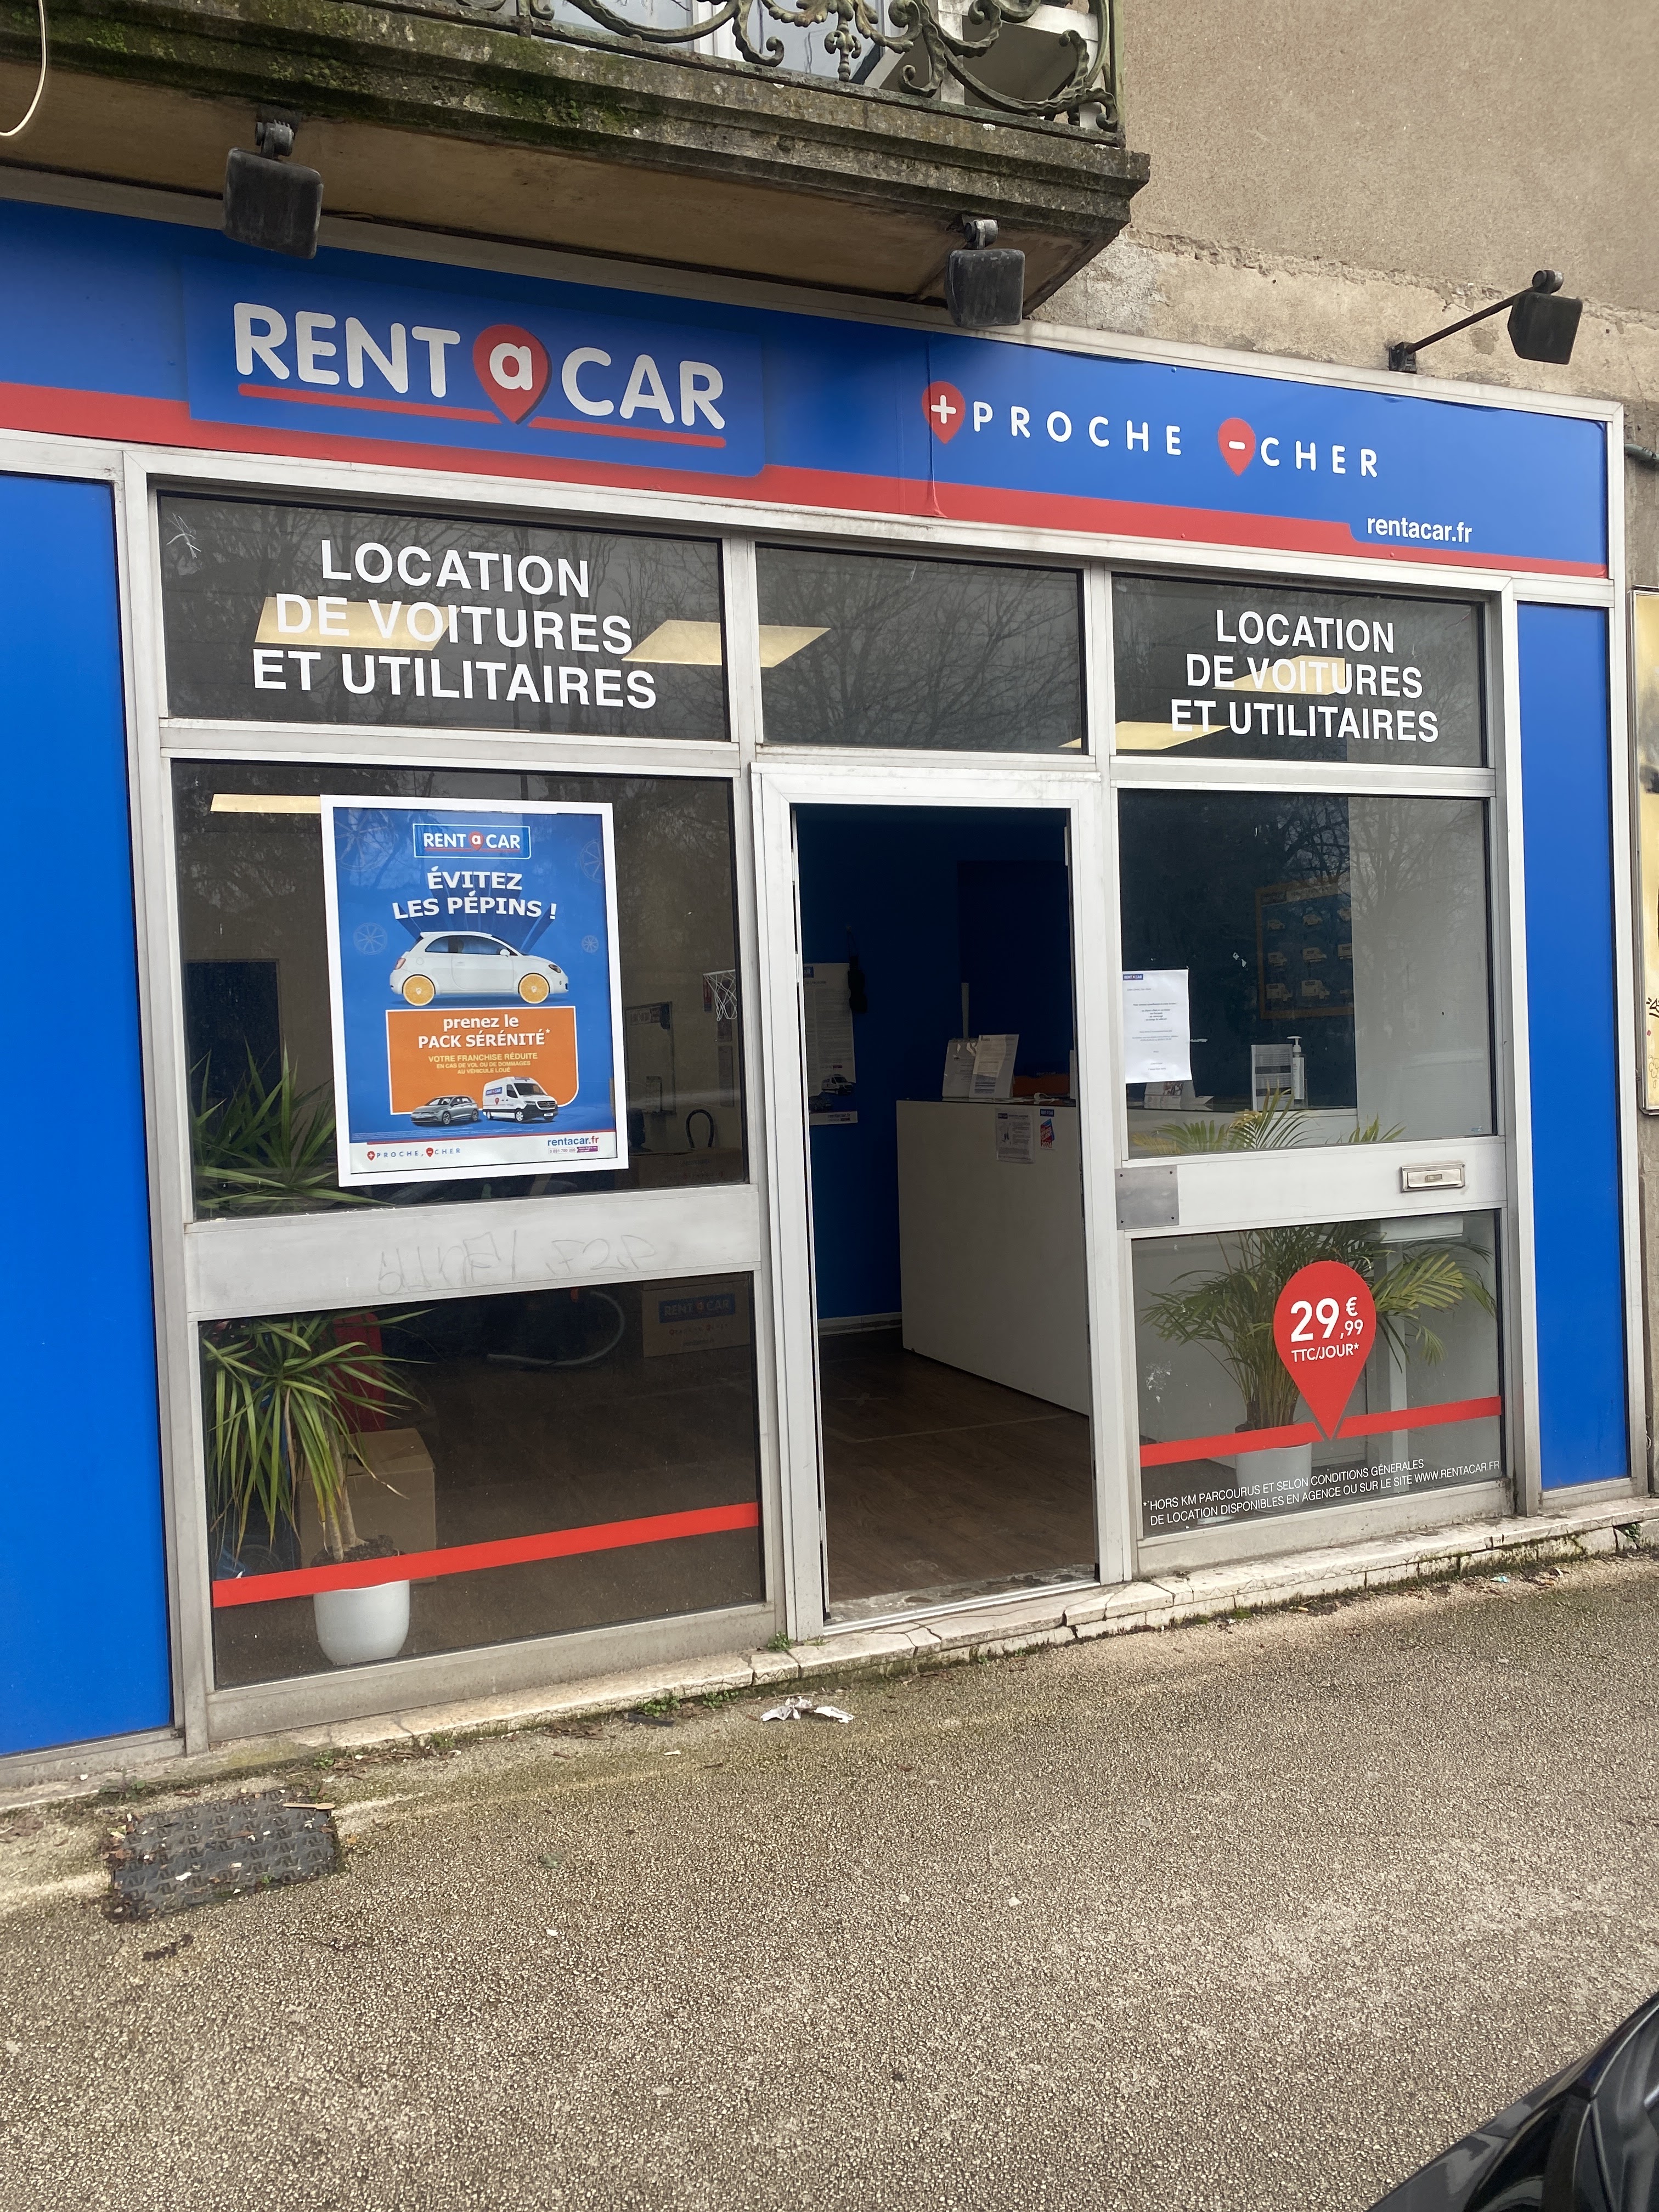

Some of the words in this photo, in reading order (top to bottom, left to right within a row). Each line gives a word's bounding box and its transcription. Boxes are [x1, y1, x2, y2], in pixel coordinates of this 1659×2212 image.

[234, 302, 460, 398] RENT
[489, 342, 532, 391] a
[561, 346, 725, 430] CAR
[1366, 515, 1472, 544] rentacar.fr
[321, 539, 589, 598] LOCATION
[276, 593, 349, 636] DE
[368, 598, 633, 655] VOITURES
[1216, 610, 1394, 654] LOCATION
[253, 648, 321, 691] ET
[342, 652, 657, 709] UTILITAIRES
[1186, 653, 1234, 688] DE
[1247, 657, 1423, 699] VOITURES
[1171, 698, 1217, 732] ET
[1229, 702, 1438, 743] UTILITAIRES
[424, 833, 466, 848] RENT
[471, 834, 481, 845] a
[486, 834, 521, 849] CAR
[427, 865, 522, 890] ÉVITEZ
[393, 899, 440, 919] LES
[447, 890, 542, 918] PÉPINS
[549, 903, 557, 919] !
[443, 1017, 500, 1032] prenez
[504, 1014, 519, 1028] le
[418, 1035, 462, 1048] PACK
[457, 1053, 503, 1062] FRANCHISE
[504, 1052, 538, 1060] RÉDUITE
[548, 1136, 599, 1146] rentacar.fr
[664, 1302, 693, 1316] RENT
[706, 1299, 730, 1311] CAR
[1150, 1514, 1164, 1526] DE
[1167, 1507, 1218, 1523] LOCATION
[1221, 1496, 1284, 1515] DISPONIBLES
[1287, 1493, 1300, 1504] EN
[1302, 1487, 1341, 1502] AGENCE
[1343, 1484, 1358, 1495] OU
[1359, 1481, 1378, 1493] SUR
[1381, 1478, 1391, 1489] LE
[1393, 1475, 1412, 1487] SITE
[1414, 1460, 1500, 1484] WWW.RENTACAR.FR
[1181, 1494, 1197, 1506] KM
[1199, 1485, 1260, 1503] PARCOURUS
[1263, 1482, 1274, 1493] ET
[1277, 1477, 1308, 1492] SELON
[1311, 1468, 1369, 1486] CONDITIONS
